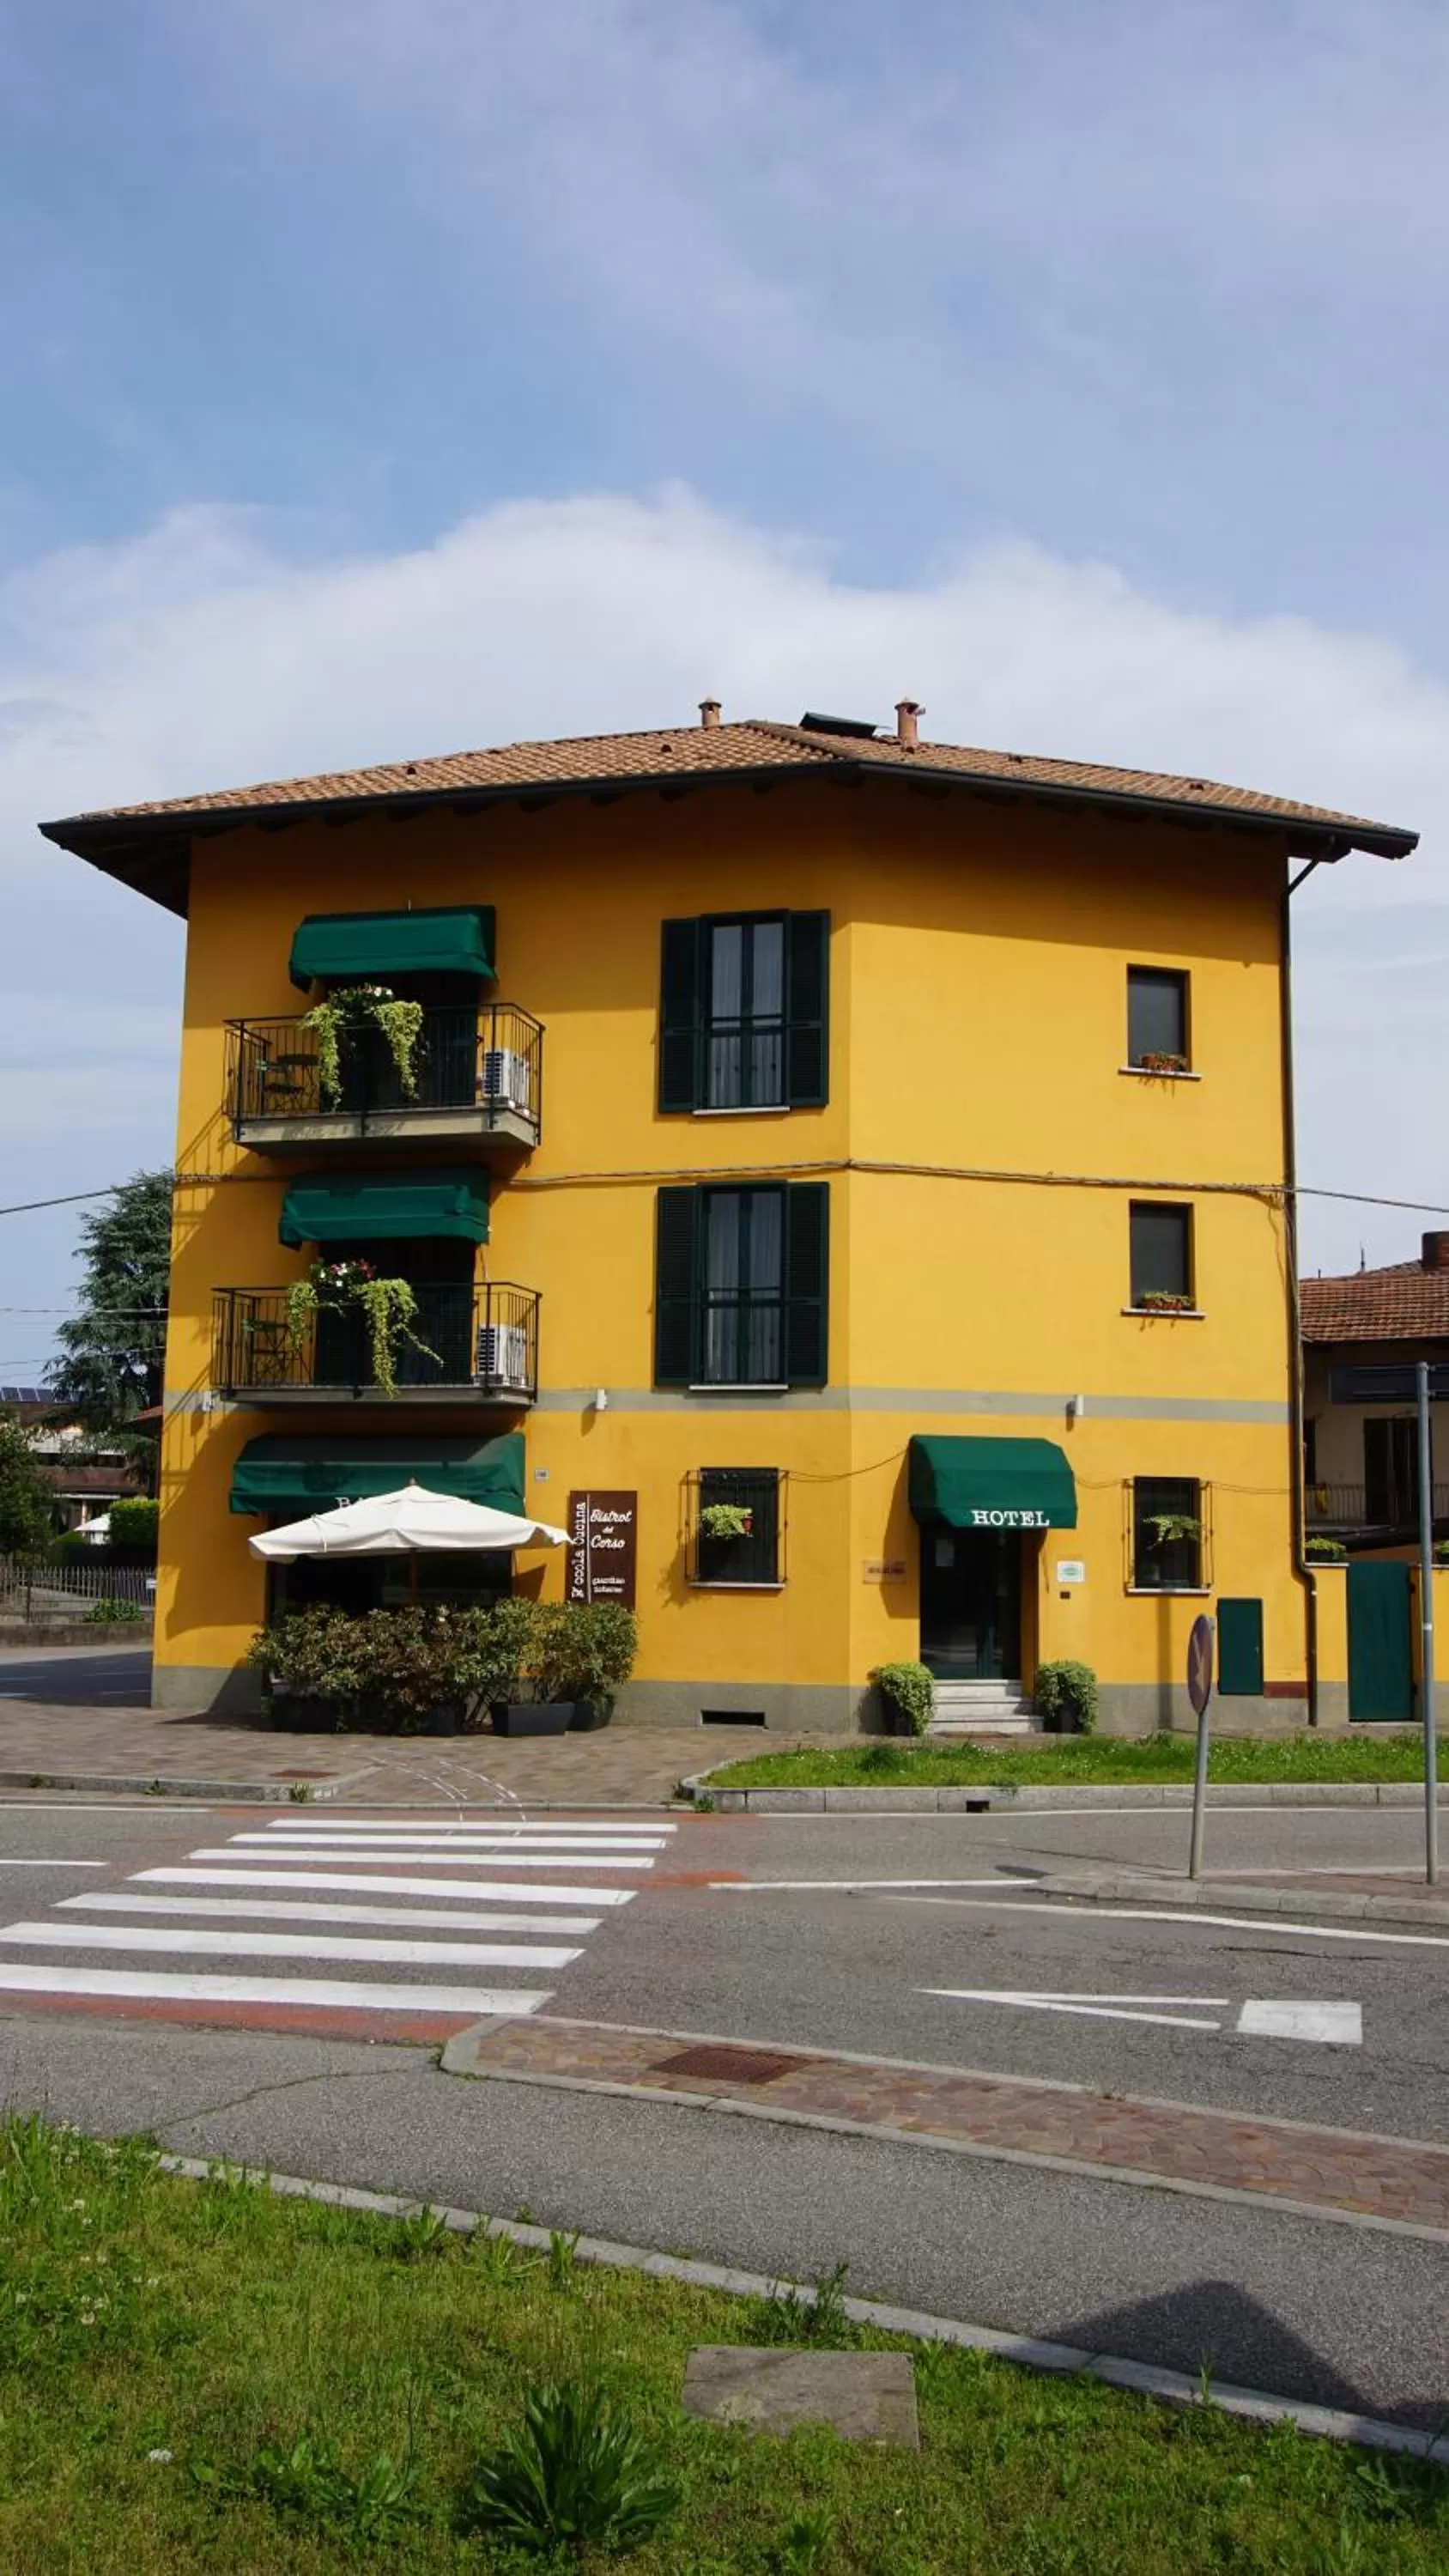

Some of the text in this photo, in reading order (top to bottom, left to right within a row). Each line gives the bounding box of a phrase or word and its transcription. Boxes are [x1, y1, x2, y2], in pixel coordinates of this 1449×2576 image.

[590, 1509, 633, 1522] Bistrot
[970, 1510, 1050, 1526] HOTEL
[573, 1502, 586, 1546] Cucina
[602, 1526, 615, 1534] del
[591, 1534, 626, 1548] Corso
